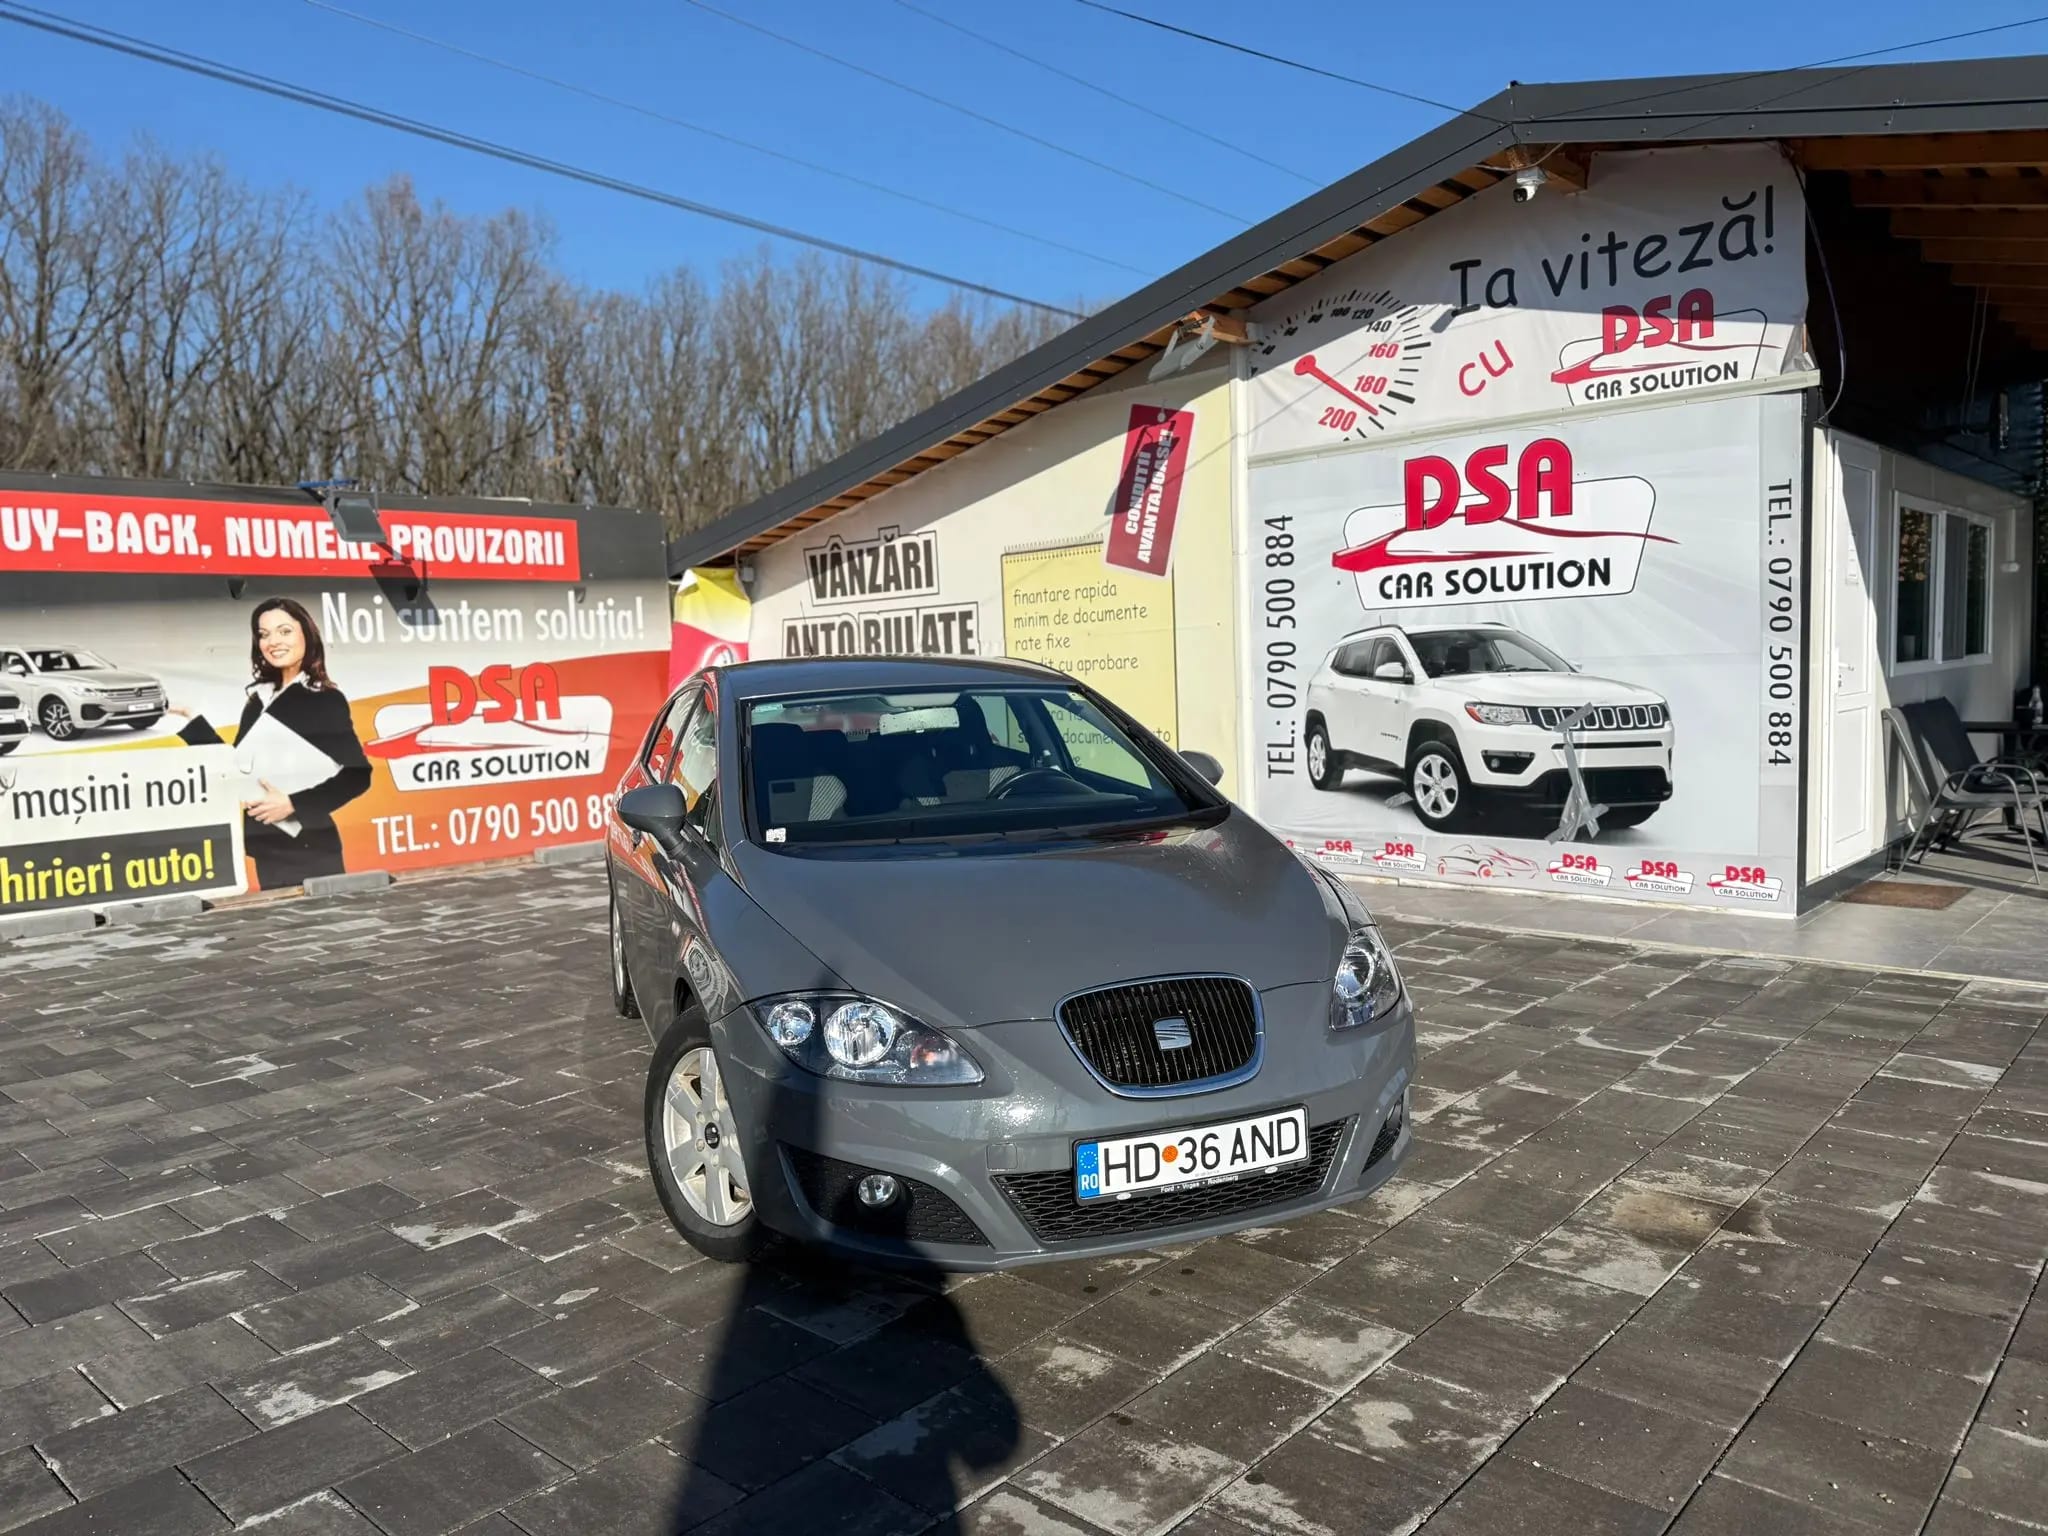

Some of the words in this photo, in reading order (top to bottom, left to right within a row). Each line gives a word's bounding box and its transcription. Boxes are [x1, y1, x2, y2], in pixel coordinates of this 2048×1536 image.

[1449, 258, 1518, 317] Ia
[1541, 184, 1775, 297] viteză!
[1351, 308, 1375, 320] 120
[1366, 320, 1392, 333] 140
[1602, 287, 1714, 355] DSA
[1368, 343, 1399, 358] 160
[1458, 339, 1514, 396] cu
[1354, 375, 1389, 395] 180
[1584, 379, 1623, 401] CAR
[1629, 360, 1739, 396] SOLUTION
[1318, 405, 1358, 432] 200
[1404, 437, 1574, 532] DSA
[1767, 478, 1793, 546] TEL.:
[389, 523, 566, 567] PROVIZORII
[1264, 515, 1295, 568] 884
[808, 533, 934, 600] VÂNZĂRI
[1378, 571, 1433, 600] CAR
[1444, 556, 1611, 597] SOLUTION
[1013, 587, 1071, 607] finantare
[1074, 581, 1118, 604] rapida
[1013, 611, 1050, 629] minim
[1053, 611, 1070, 626] de
[1073, 603, 1148, 625] documente
[1265, 578, 1297, 630] 500
[1768, 557, 1793, 632] 0790
[320, 592, 386, 645] Noi
[398, 599, 524, 644] suntem
[1015, 635, 1042, 651] rate
[1046, 632, 1071, 650] fixe
[1076, 652, 1139, 677] aprobare
[1266, 641, 1297, 708] 0790
[1768, 645, 1793, 700] 500
[428, 661, 562, 726] DSA
[1267, 719, 1296, 779] TEL.:
[1768, 711, 1793, 767] 884
[412, 759, 461, 783] CAR
[470, 749, 590, 779] SOLUTION
[12, 771, 131, 825] mașini
[145, 764, 208, 808] noi!
[371, 814, 441, 856] TEL.:
[448, 803, 521, 847] 0790
[530, 796, 579, 837] 500
[1324, 840, 1353, 853] DSA
[125, 838, 216, 889] auto!
[1384, 841, 1415, 857] DSA
[1561, 852, 1597, 871] DSA
[1640, 859, 1678, 878] DSA
[1556, 874, 1569, 882] CAR
[1570, 875, 1604, 885] SOLUTION
[1635, 881, 1649, 889] CAR
[1650, 883, 1686, 893] SOLUTION
[1718, 888, 1734, 896] CAR
[1735, 889, 1773, 900] SOLUTION
[1725, 865, 1766, 884] DSA
[1103, 1142, 1161, 1187] HD
[1177, 1132, 1221, 1175] 36
[1229, 1116, 1300, 1167] AND
[1081, 1172, 1099, 1191] RO
